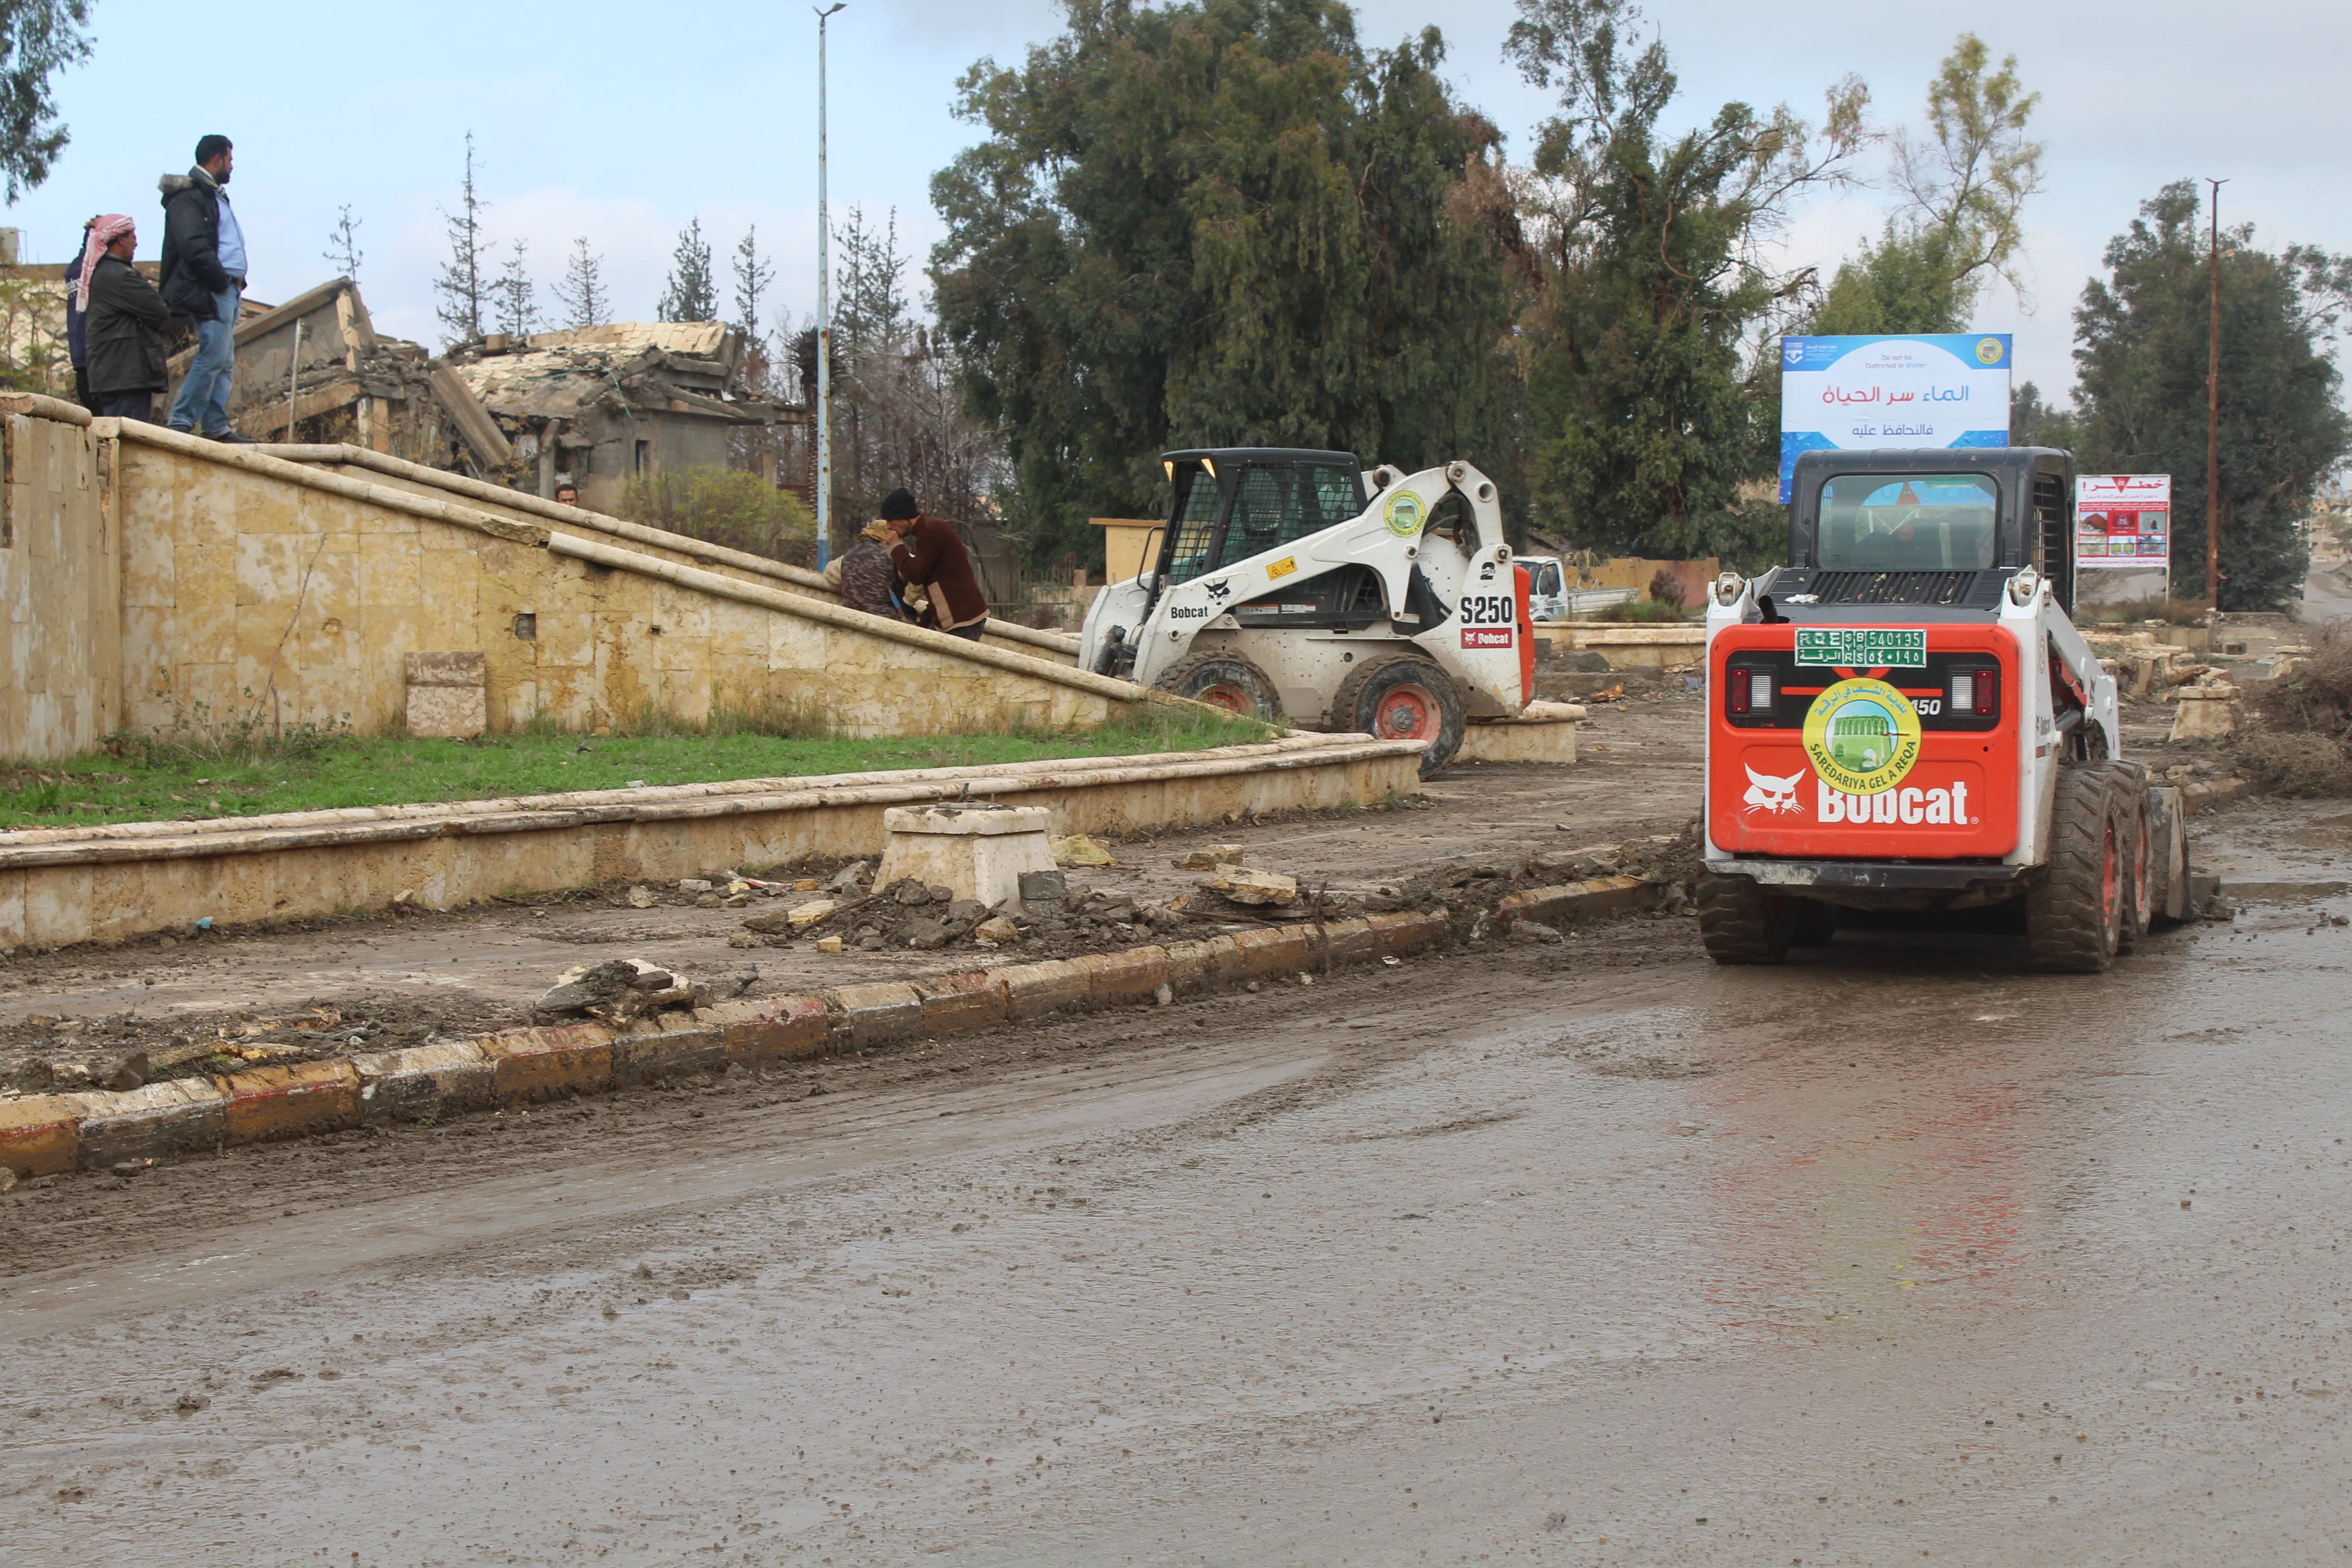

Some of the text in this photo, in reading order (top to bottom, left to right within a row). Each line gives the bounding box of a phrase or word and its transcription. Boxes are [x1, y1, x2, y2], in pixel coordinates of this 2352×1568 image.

[1822, 385, 1969, 407] الماء سر الحياة
[1852, 424, 1933, 438] فالنحافظ عليه
[1171, 606, 1209, 619] Bobcat
[1460, 596, 1513, 624] S250
[1478, 632, 1509, 644] Bobcat
[1799, 650, 1841, 662] الرقة
[1814, 684, 1907, 715] بلدية الشعب في الرقة
[1869, 774, 1888, 789] GEL
[1887, 769, 1897, 781] A
[1895, 741, 1916, 772] REQA
